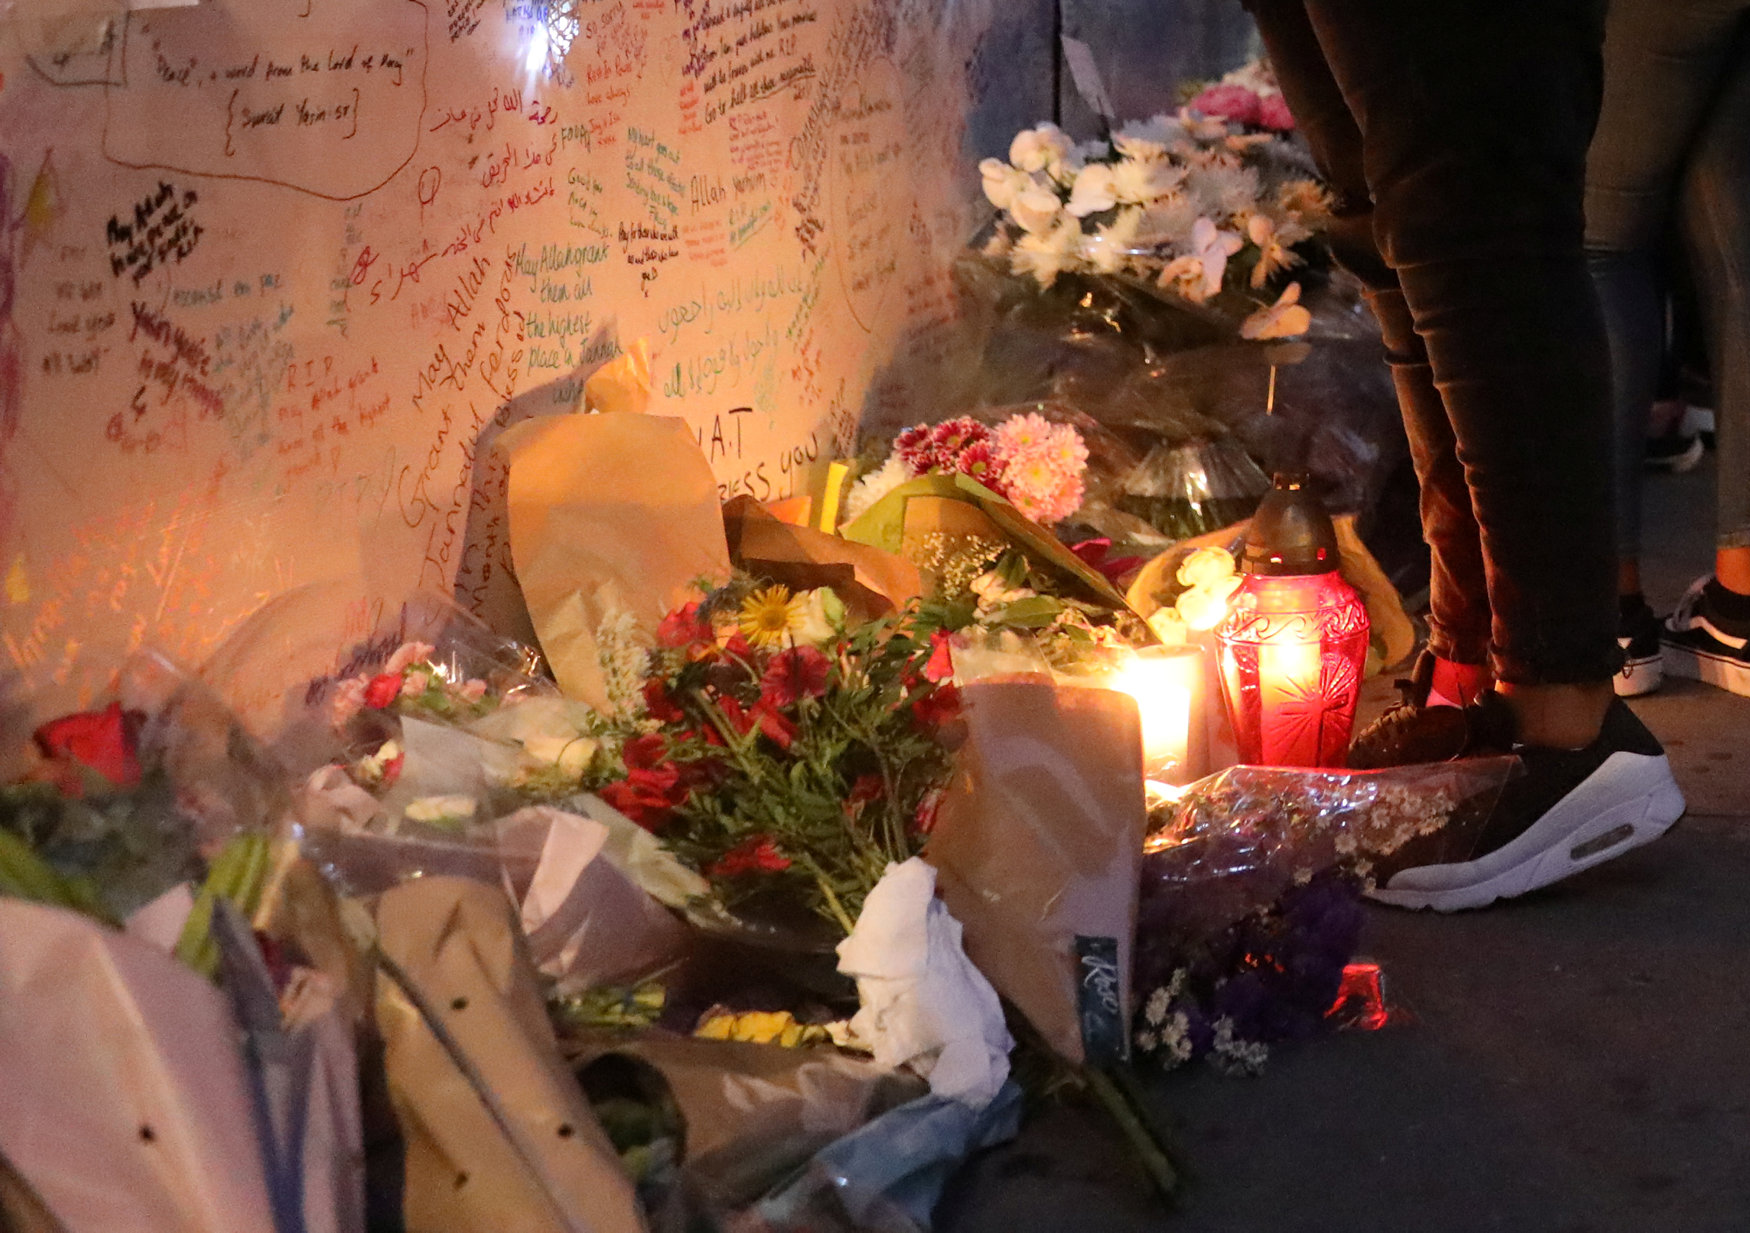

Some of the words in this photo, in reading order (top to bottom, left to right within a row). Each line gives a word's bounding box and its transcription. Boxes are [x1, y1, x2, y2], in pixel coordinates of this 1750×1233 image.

[690, 174, 726, 216] Allah
[539, 278, 570, 304] them
[574, 278, 594, 301] all
[411, 343, 451, 414] May
[446, 255, 492, 333] Allah
[525, 312, 546, 341] the
[547, 313, 592, 349] highest
[527, 350, 560, 377] place
[398, 403, 454, 531] Grant
